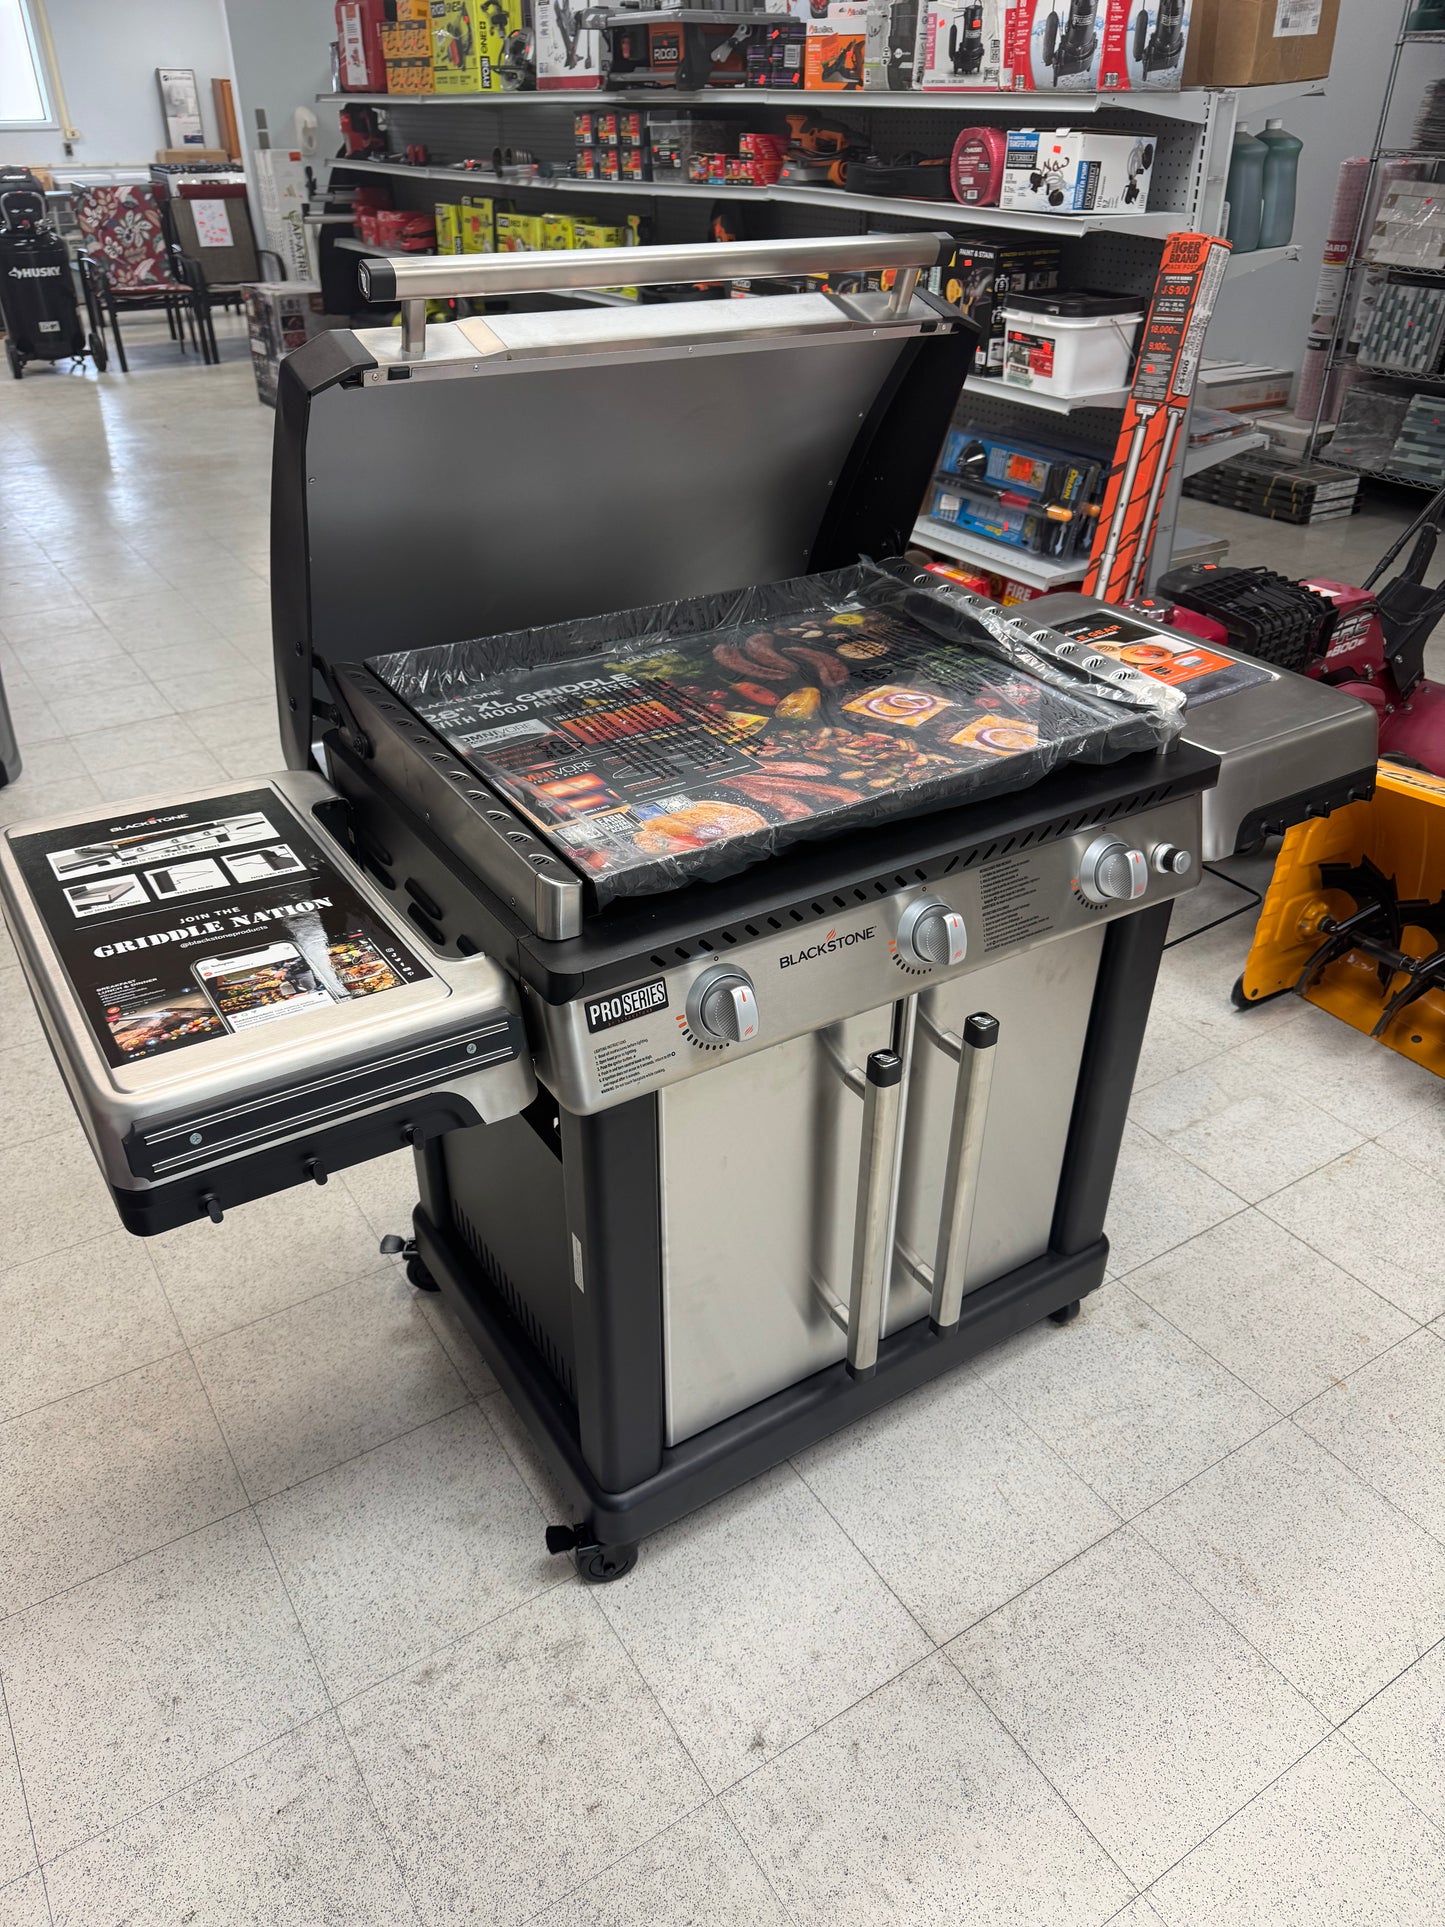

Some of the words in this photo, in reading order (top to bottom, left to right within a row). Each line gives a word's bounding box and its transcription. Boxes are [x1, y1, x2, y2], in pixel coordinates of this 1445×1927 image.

[481, 57, 490, 87] RYOBI
[1172, 242, 1201, 254] TIGER
[1169, 254, 1199, 263] BRAND
[22, 266, 61, 278] HUSKY
[1005, 582, 1032, 601] FIRE
[1087, 624, 1122, 639] GEAR
[472, 698, 513, 713] XL
[515, 673, 633, 703] GRIDDLE
[480, 704, 529, 720] HOOD
[109, 813, 189, 833] BLACKSTONE
[179, 913, 210, 924] JOIN
[214, 906, 241, 918] THE
[93, 920, 224, 958] GRIDDLE
[229, 897, 333, 928] NATION
[779, 926, 876, 969] BLACKSTONE
[589, 997, 622, 1026] PRO
[623, 983, 665, 1014] SERIES
